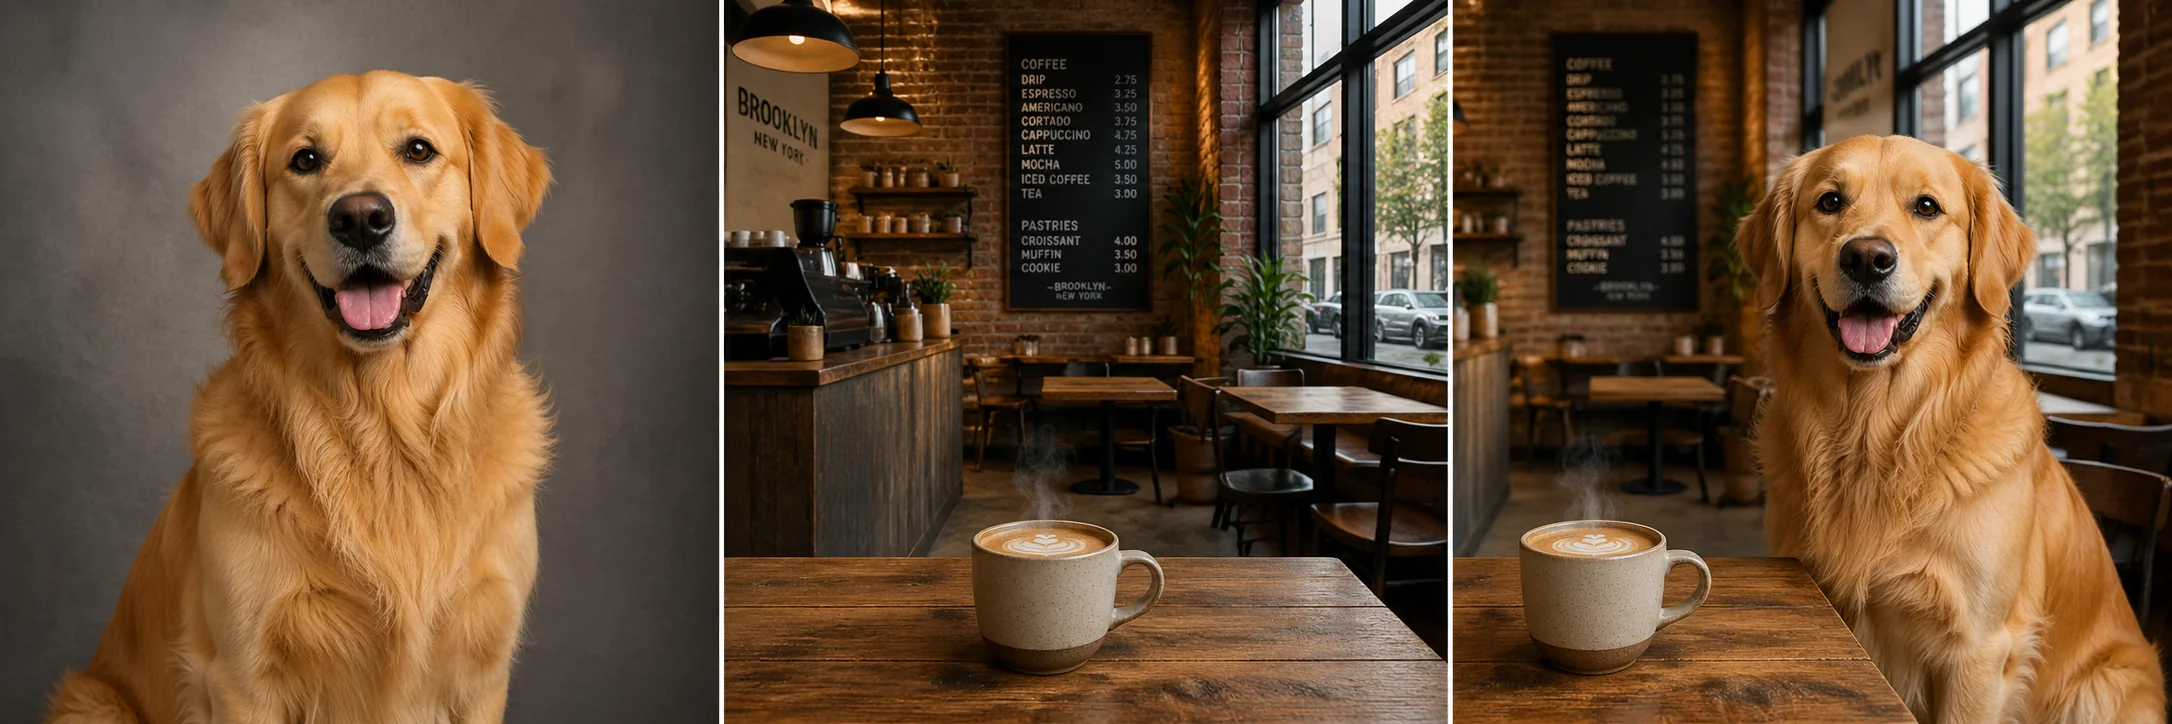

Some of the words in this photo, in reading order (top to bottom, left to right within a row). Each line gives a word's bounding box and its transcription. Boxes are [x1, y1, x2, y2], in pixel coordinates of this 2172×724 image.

[1021, 59, 1067, 70] COFFEE
[1021, 74, 1046, 85] DRIP
[1114, 75, 1138, 84] 2.75
[1021, 88, 1077, 99] ESPRESSO
[1114, 89, 1138, 99] 3.25
[1021, 103, 1083, 113] AMERICANO
[1114, 103, 1138, 113] 3.50
[738, 86, 818, 150] BROOKLYN
[1021, 116, 1071, 126] CORTADO
[1114, 116, 1138, 126] 3.75
[1021, 130, 1091, 140] CAPPUCCINO
[754, 131, 778, 153] NEW
[781, 143, 804, 166] YORK
[1021, 144, 1055, 155] LATTE
[1114, 145, 1138, 155] 4.25
[1021, 159, 1060, 170] MOCHA
[1114, 160, 1138, 170] 5.00
[1021, 174, 1045, 185] ICED
[1049, 174, 1091, 185] COFFEE
[1021, 188, 1042, 199] TEA
[1021, 220, 1079, 231] PASTRIES
[1021, 236, 1081, 246] CROISSANT
[1114, 236, 1138, 246] 4.00
[1021, 249, 1062, 260] MUFFIN
[1114, 250, 1138, 260] 3.50
[1021, 263, 1061, 273] COOKIE
[1114, 263, 1138, 273] 3.00
[1078, 291, 1103, 300] YORK
